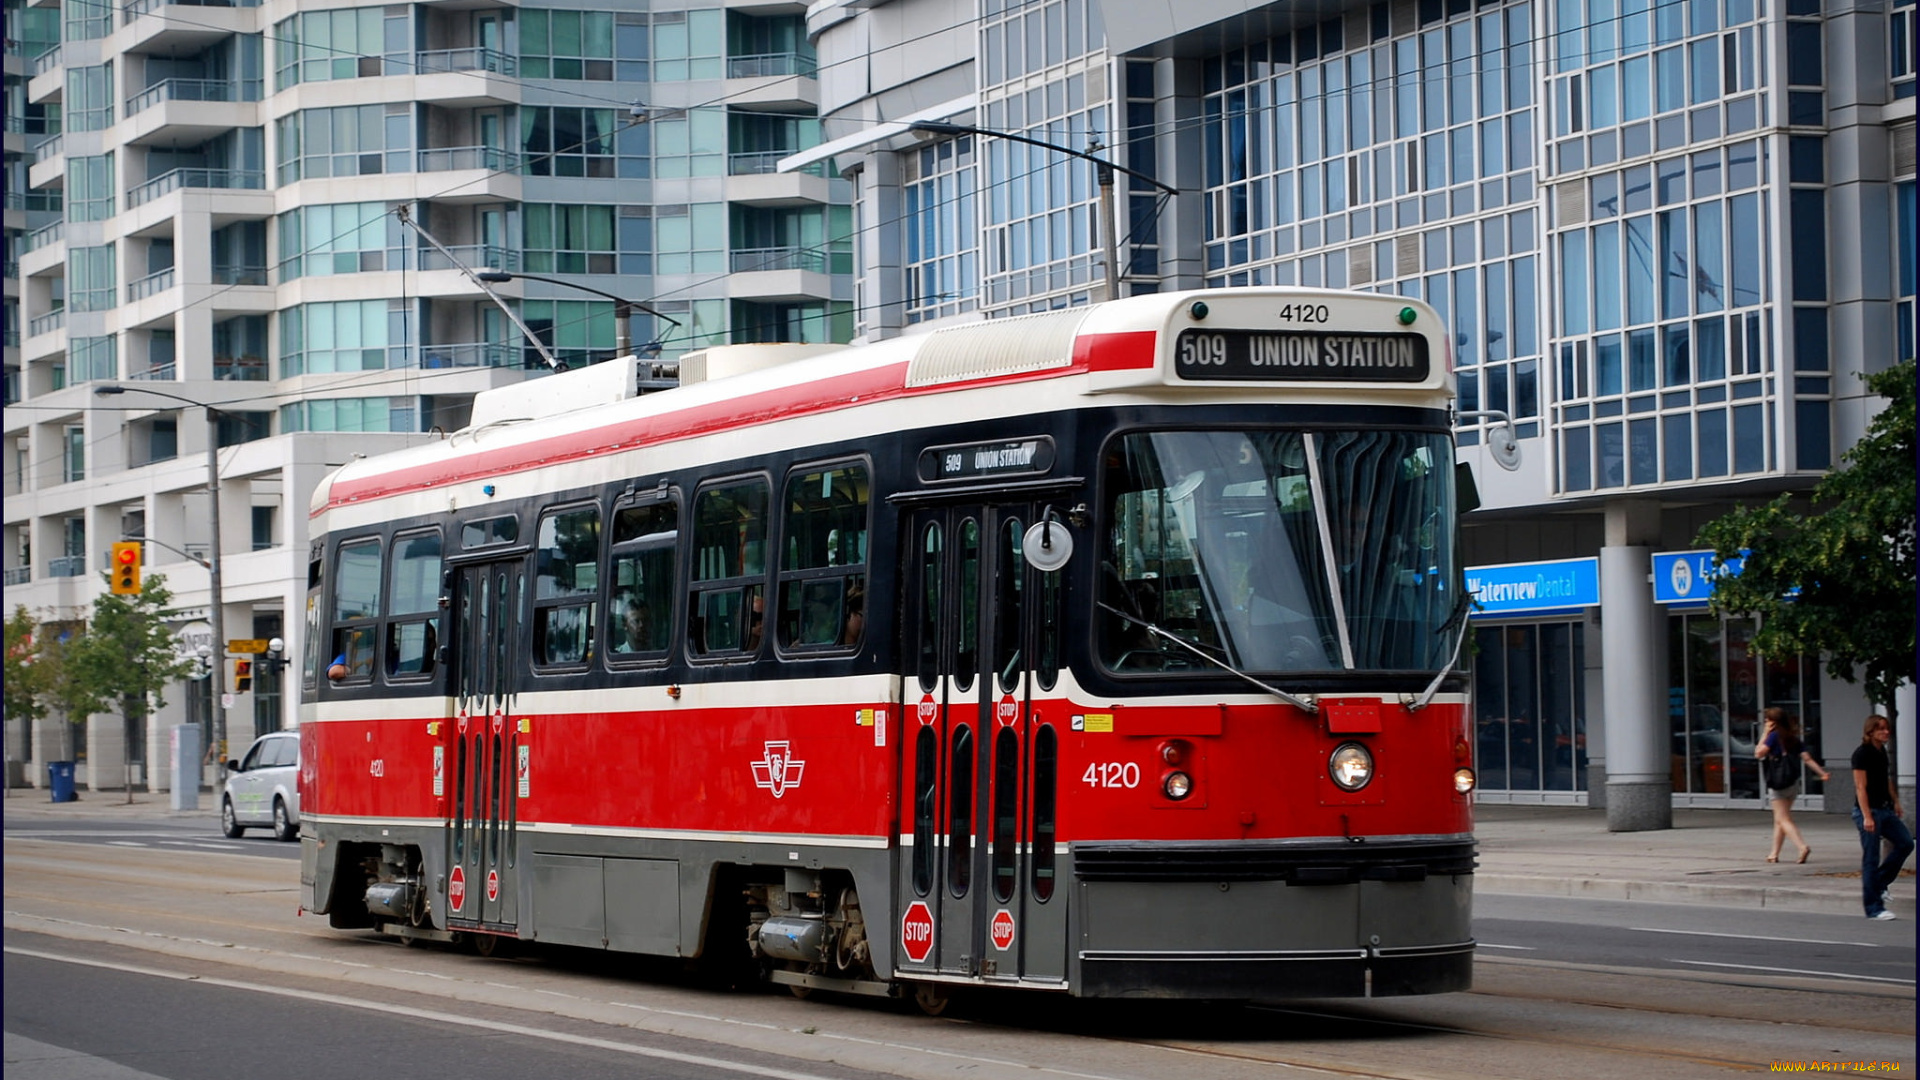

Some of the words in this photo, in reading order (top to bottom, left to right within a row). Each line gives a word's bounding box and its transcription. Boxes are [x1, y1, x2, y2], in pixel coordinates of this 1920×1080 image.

[1280, 304, 1329, 323] 4120
[1181, 334, 1227, 366] 509
[1249, 335, 1319, 367] UNION
[1324, 337, 1414, 368] STATION
[945, 454, 962, 472] 509
[975, 450, 999, 470] UNION
[999, 447, 1033, 467] STATION
[920, 702, 935, 716] STOP
[999, 702, 1015, 717] STOP
[370, 759, 384, 777] 4120
[1082, 762, 1141, 788] 4120
[450, 880, 464, 892] STOP
[487, 879, 498, 891] STOP
[905, 922, 931, 941] STOP
[993, 921, 1012, 939] STOP
